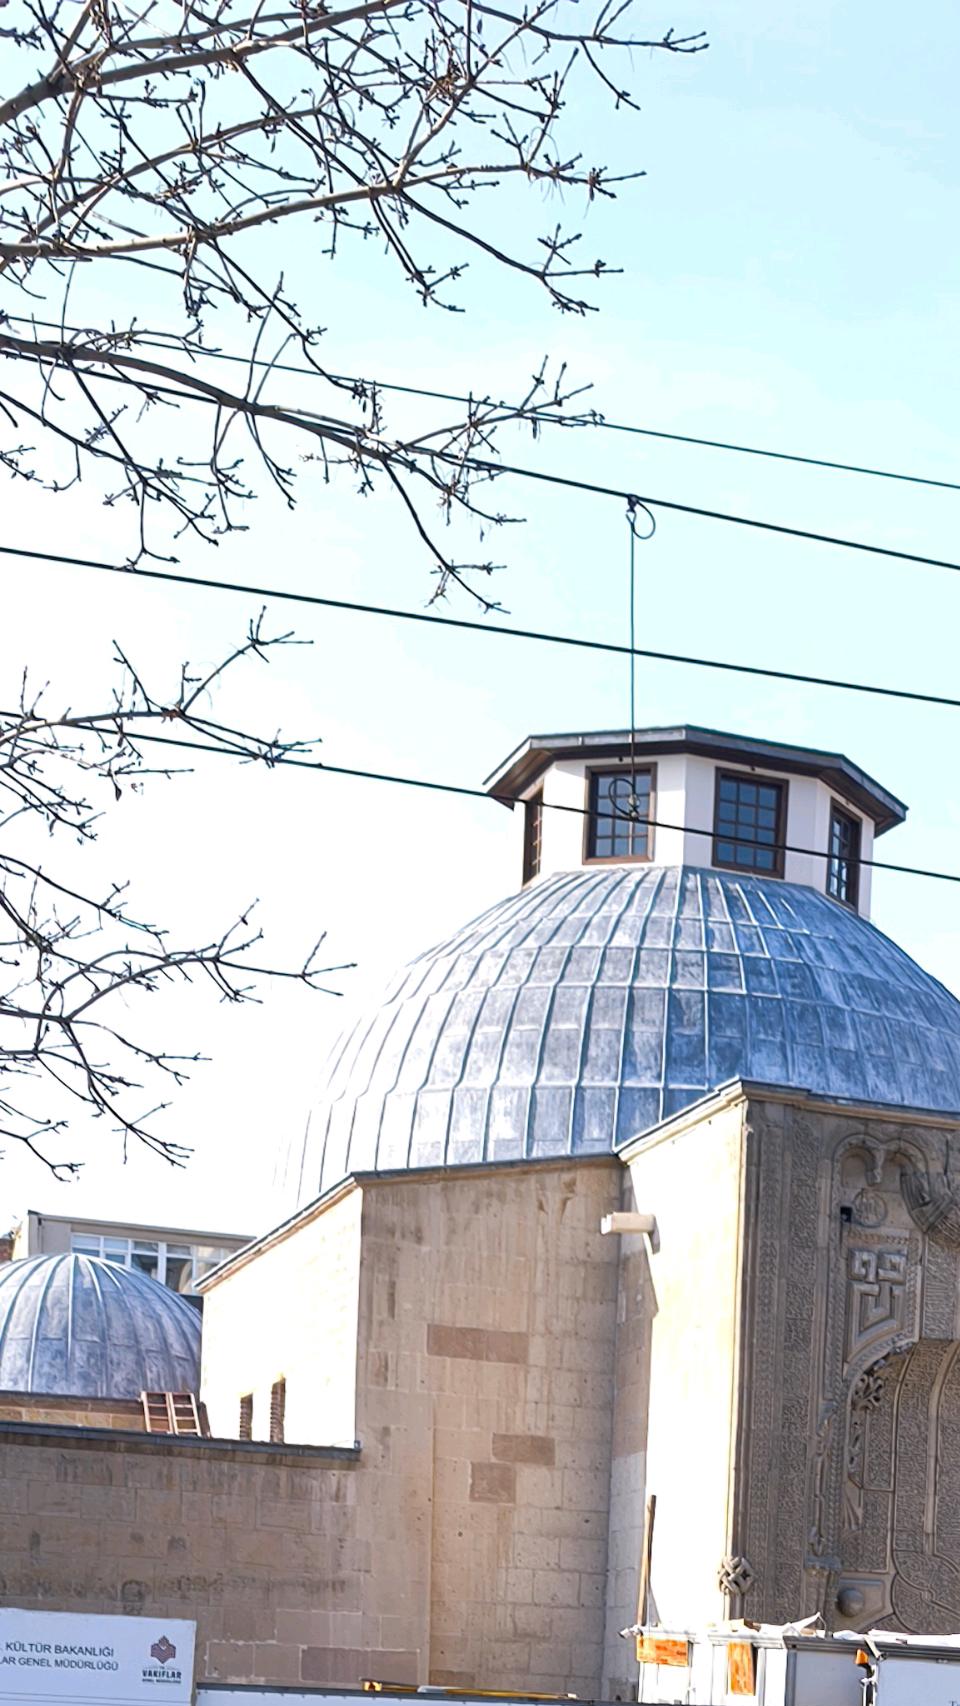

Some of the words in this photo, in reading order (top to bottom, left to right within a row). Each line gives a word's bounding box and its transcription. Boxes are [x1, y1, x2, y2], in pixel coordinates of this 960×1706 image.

[6, 1641, 51, 1654] KÜLTÜR
[54, 1645, 114, 1657] BAKANLIĞI
[18, 1658, 52, 1667] GENEL
[54, 1659, 119, 1671] MÜDÜRLÜĞÜ
[142, 1670, 182, 1679] VAKIFLAR
